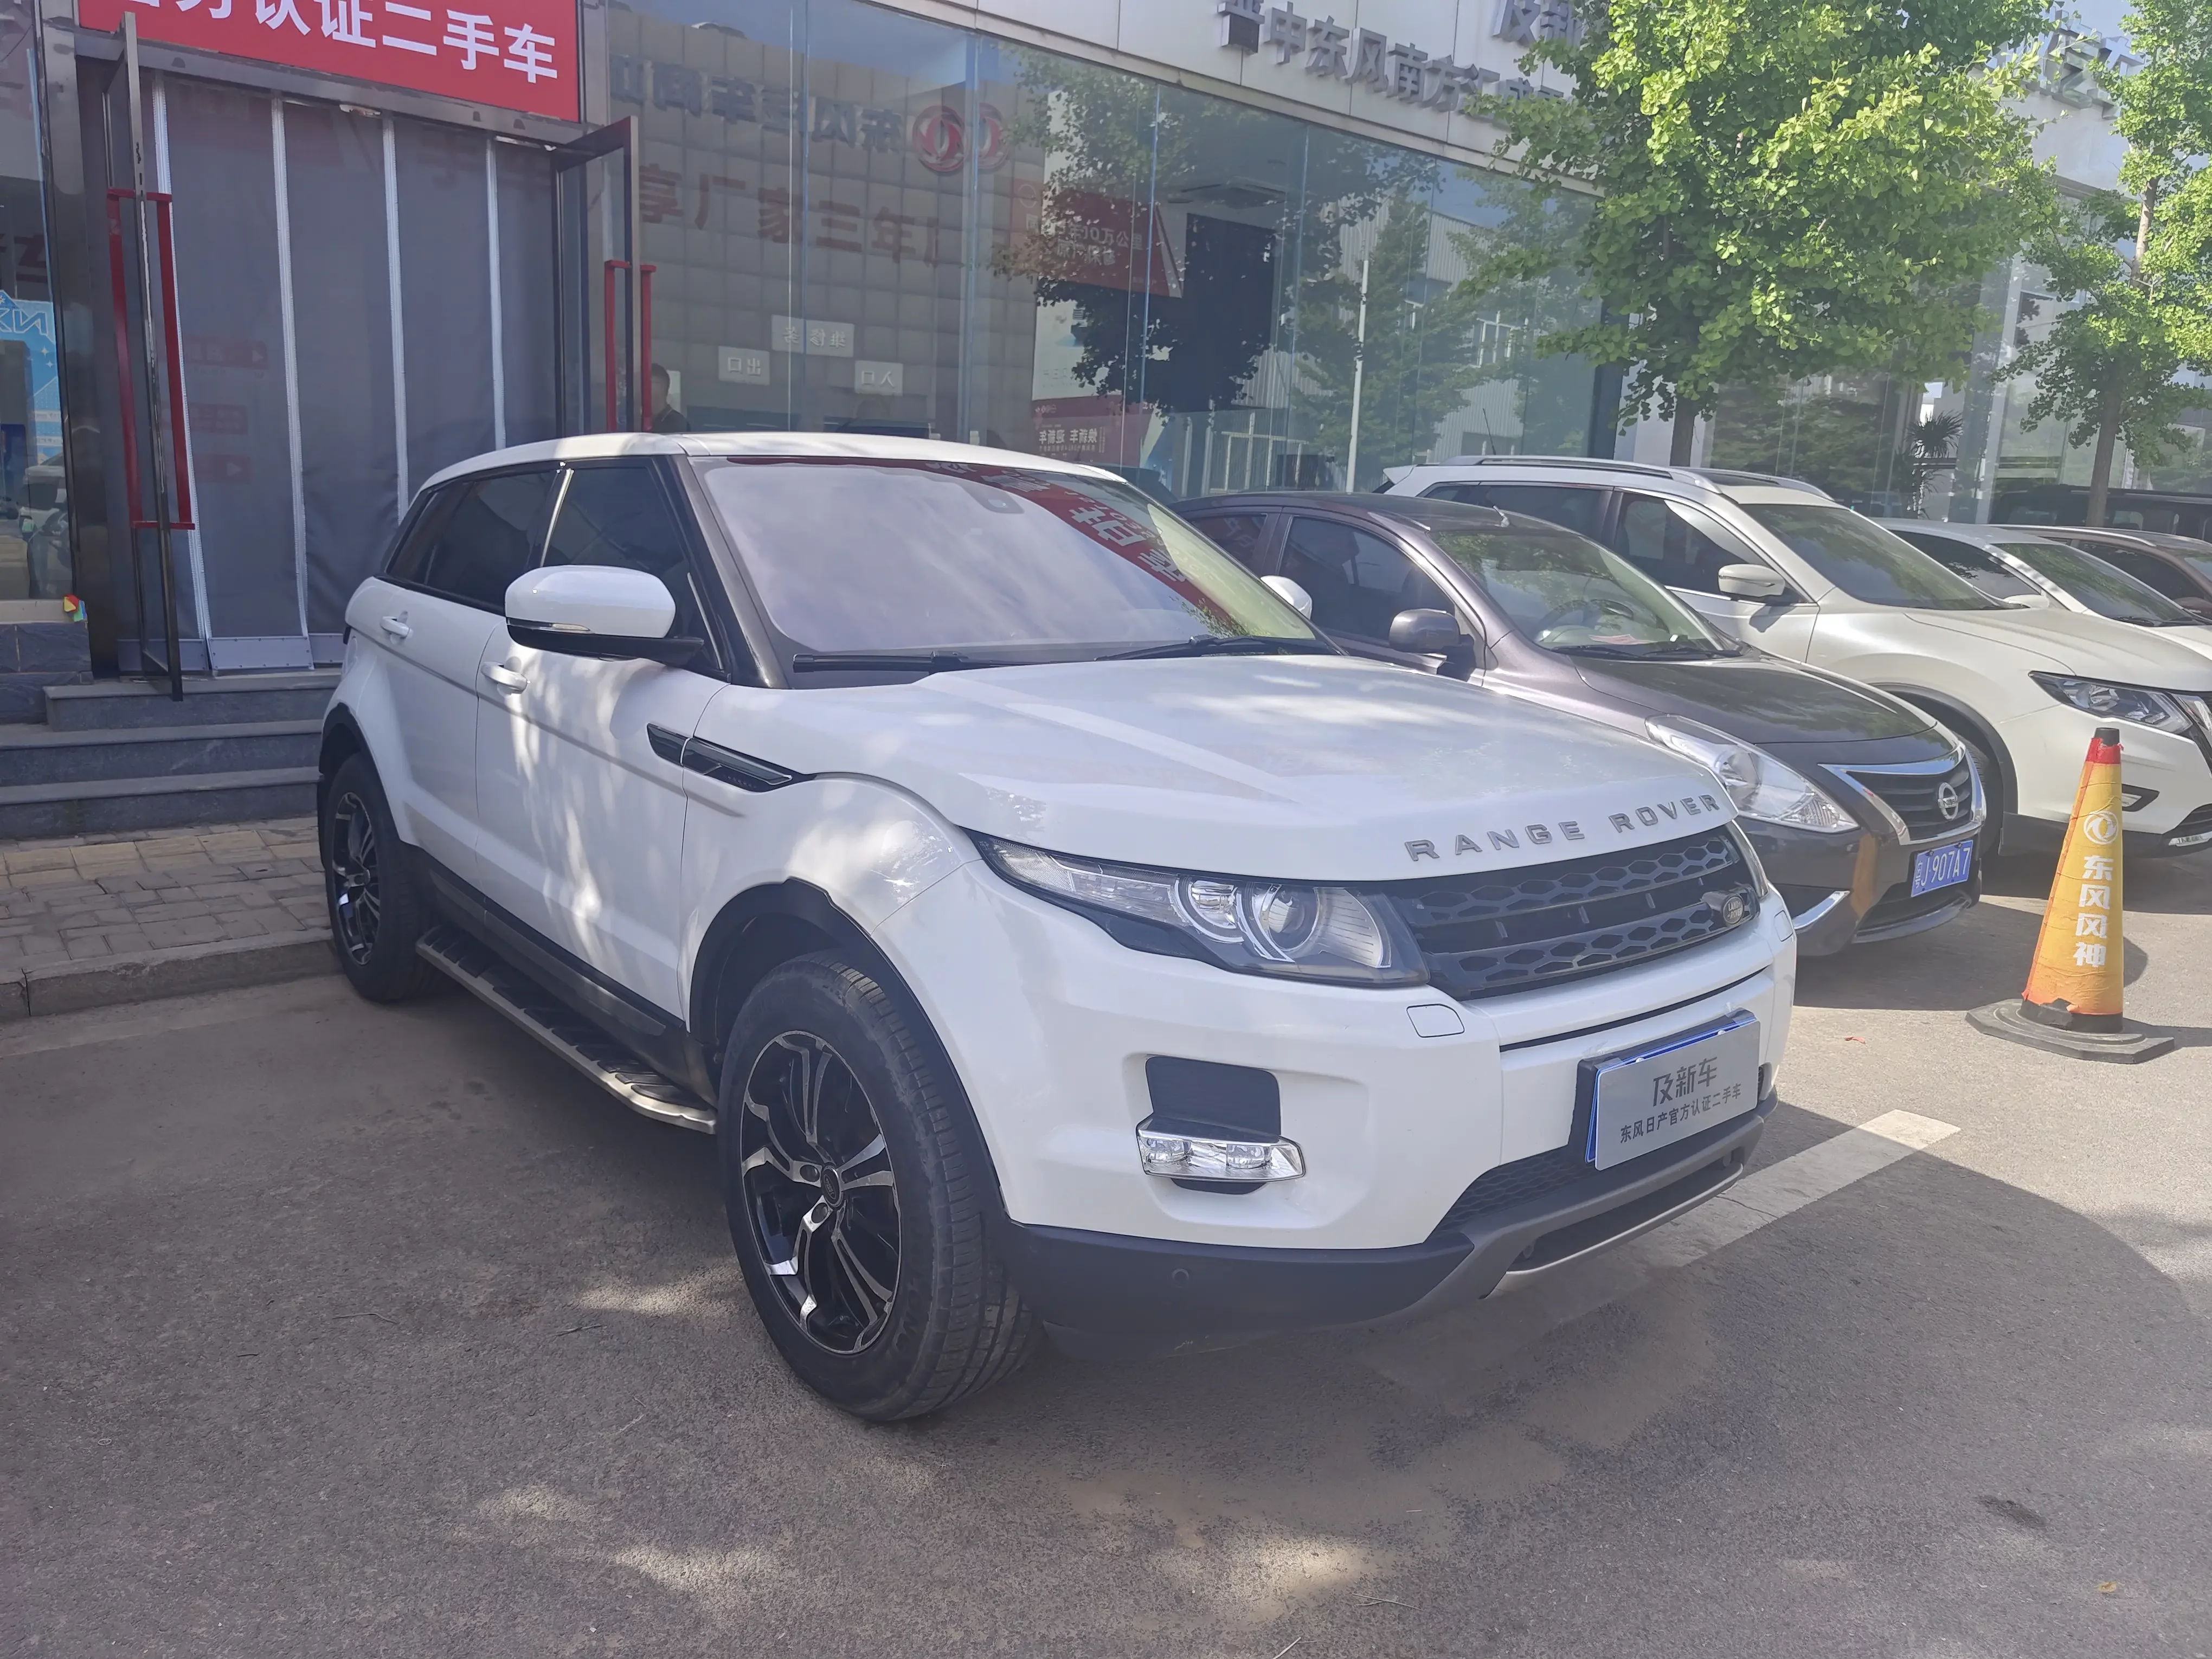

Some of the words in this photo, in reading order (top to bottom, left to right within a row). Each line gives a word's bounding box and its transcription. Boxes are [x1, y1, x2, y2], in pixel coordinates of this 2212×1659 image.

[127, 0, 557, 83] 认证二手车
[1404, 820, 1585, 861] RANGE
[1608, 794, 1720, 833] ROVER
[2073, 854, 2114, 968] 东风风神
[1620, 1083, 1741, 1144] 东风日产官方认证二手车
[1652, 1056, 1718, 1107] 及新车
